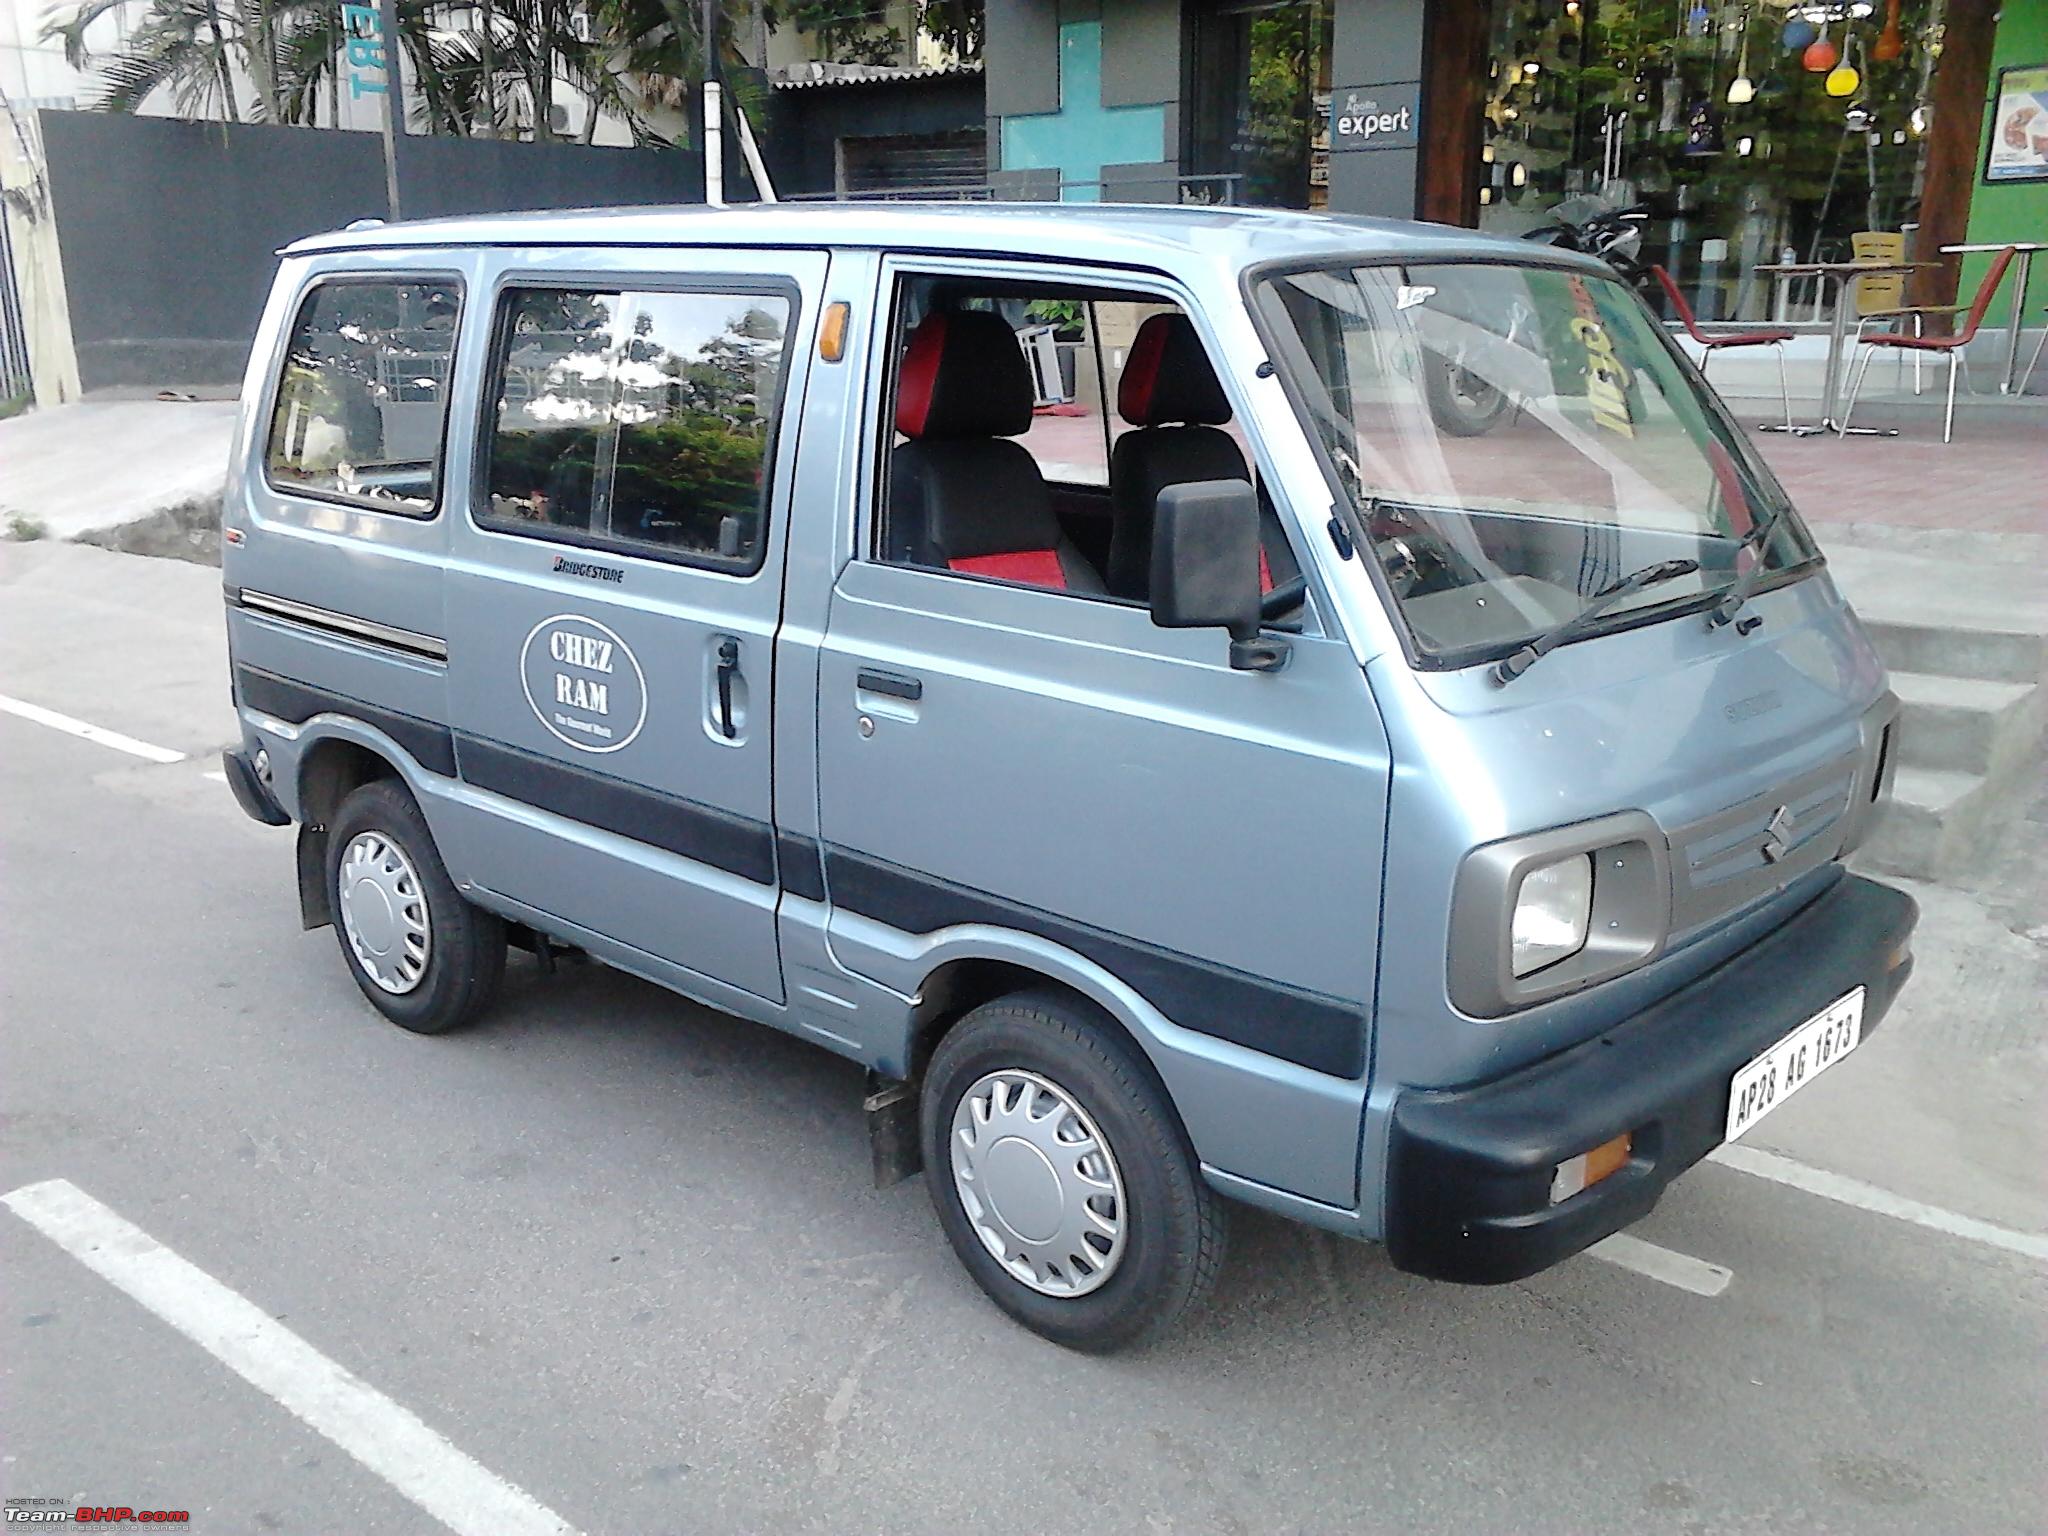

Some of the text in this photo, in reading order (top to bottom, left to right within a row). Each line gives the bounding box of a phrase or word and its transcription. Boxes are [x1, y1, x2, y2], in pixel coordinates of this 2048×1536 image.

[1338, 106, 1409, 139] expert
[550, 630, 613, 674] CHEZ
[556, 673, 609, 715] RAM
[1736, 1013, 1853, 1128] AP28 AG 1673
